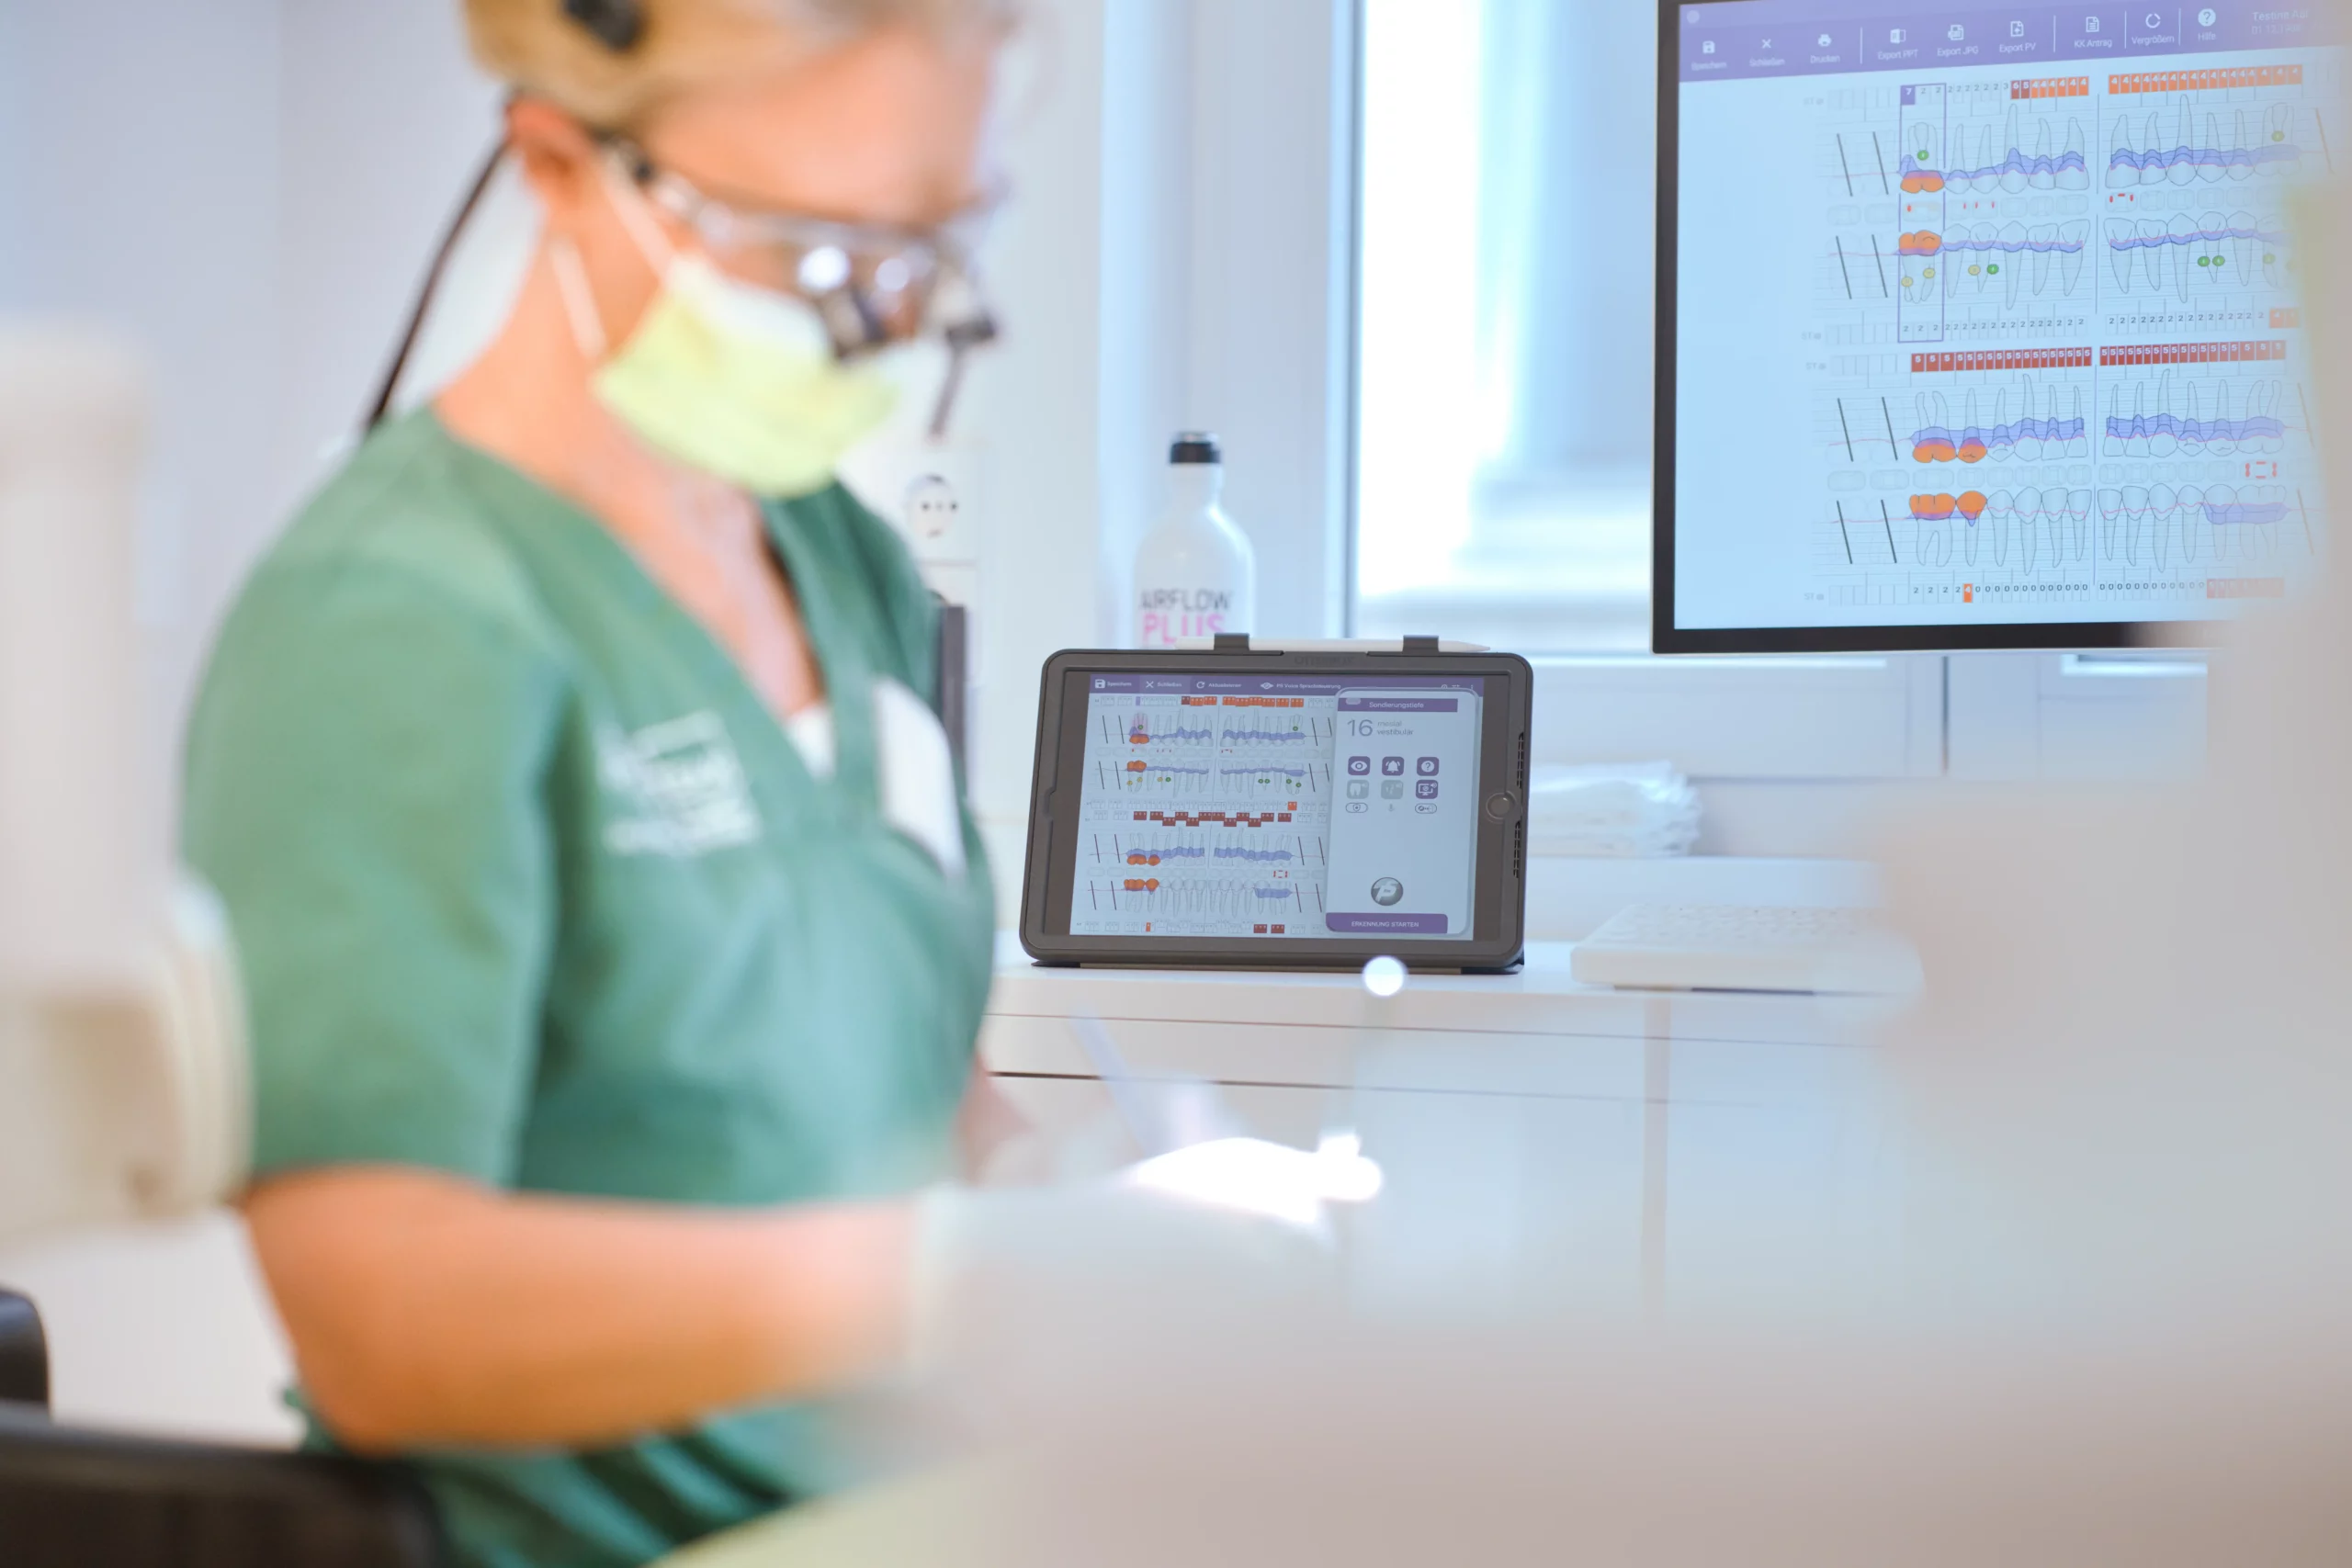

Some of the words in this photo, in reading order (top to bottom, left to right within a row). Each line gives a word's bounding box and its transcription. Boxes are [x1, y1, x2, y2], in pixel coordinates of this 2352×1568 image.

[2198, 32, 2216, 41] Hilfe
[1999, 43, 2023, 53] Export
[2025, 42, 2036, 51] PV
[2075, 39, 2086, 48] KK
[2086, 39, 2112, 48] Antrag
[1878, 51, 1902, 61] Export
[1903, 49, 1918, 58] PPT
[1937, 47, 1961, 57] Export
[1962, 46, 1979, 55] JPG
[1139, 589, 1233, 610] AIRFLOW
[1142, 614, 1225, 643] PLUS
[1347, 718, 1373, 737] 16
